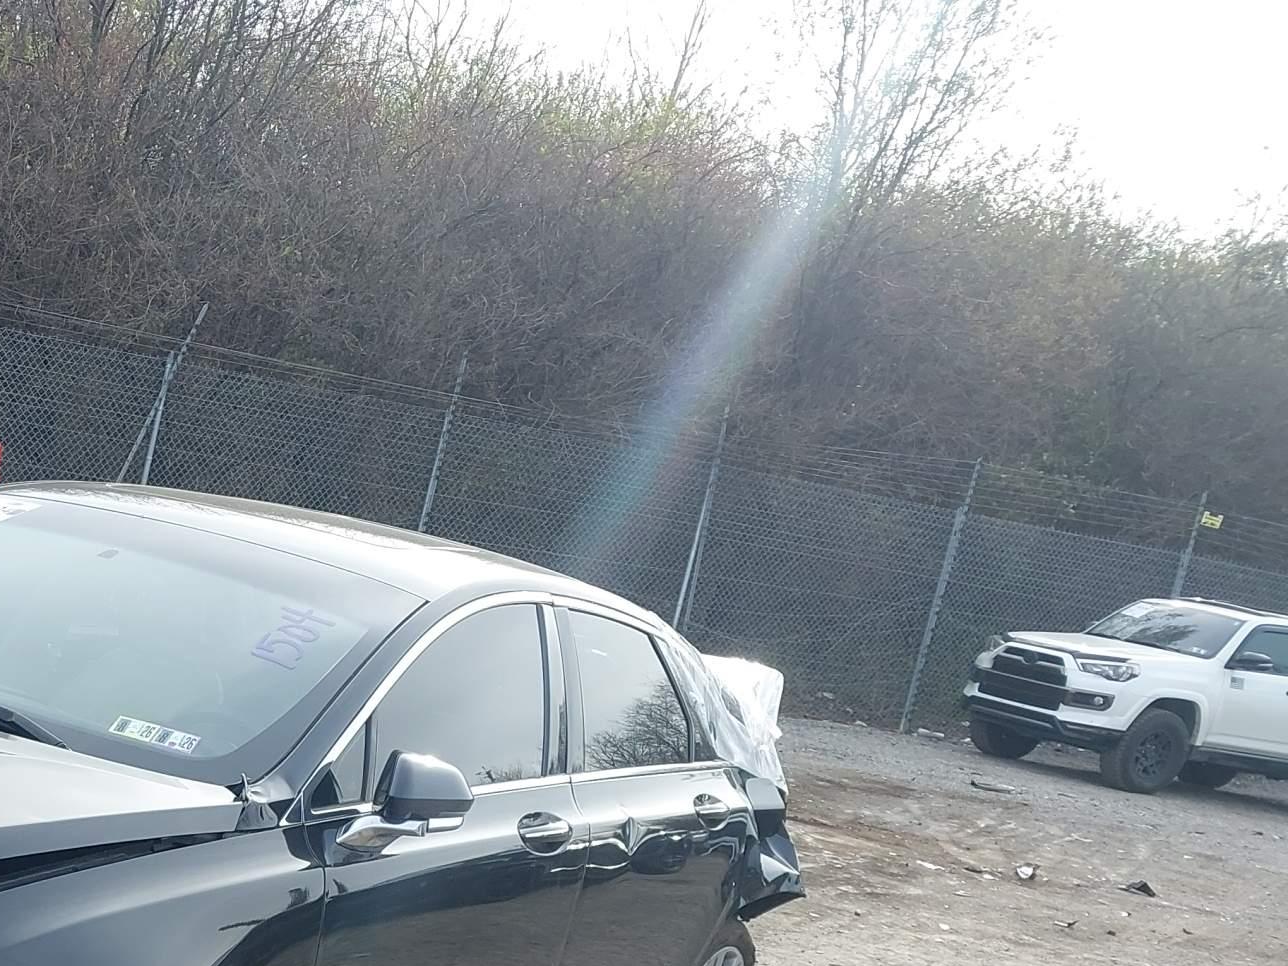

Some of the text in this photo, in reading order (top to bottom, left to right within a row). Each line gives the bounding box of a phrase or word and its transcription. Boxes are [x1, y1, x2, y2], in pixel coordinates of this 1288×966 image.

[250, 606, 336, 670] 1504
[139, 725, 155, 739] 26
[182, 736, 197, 750] 26
